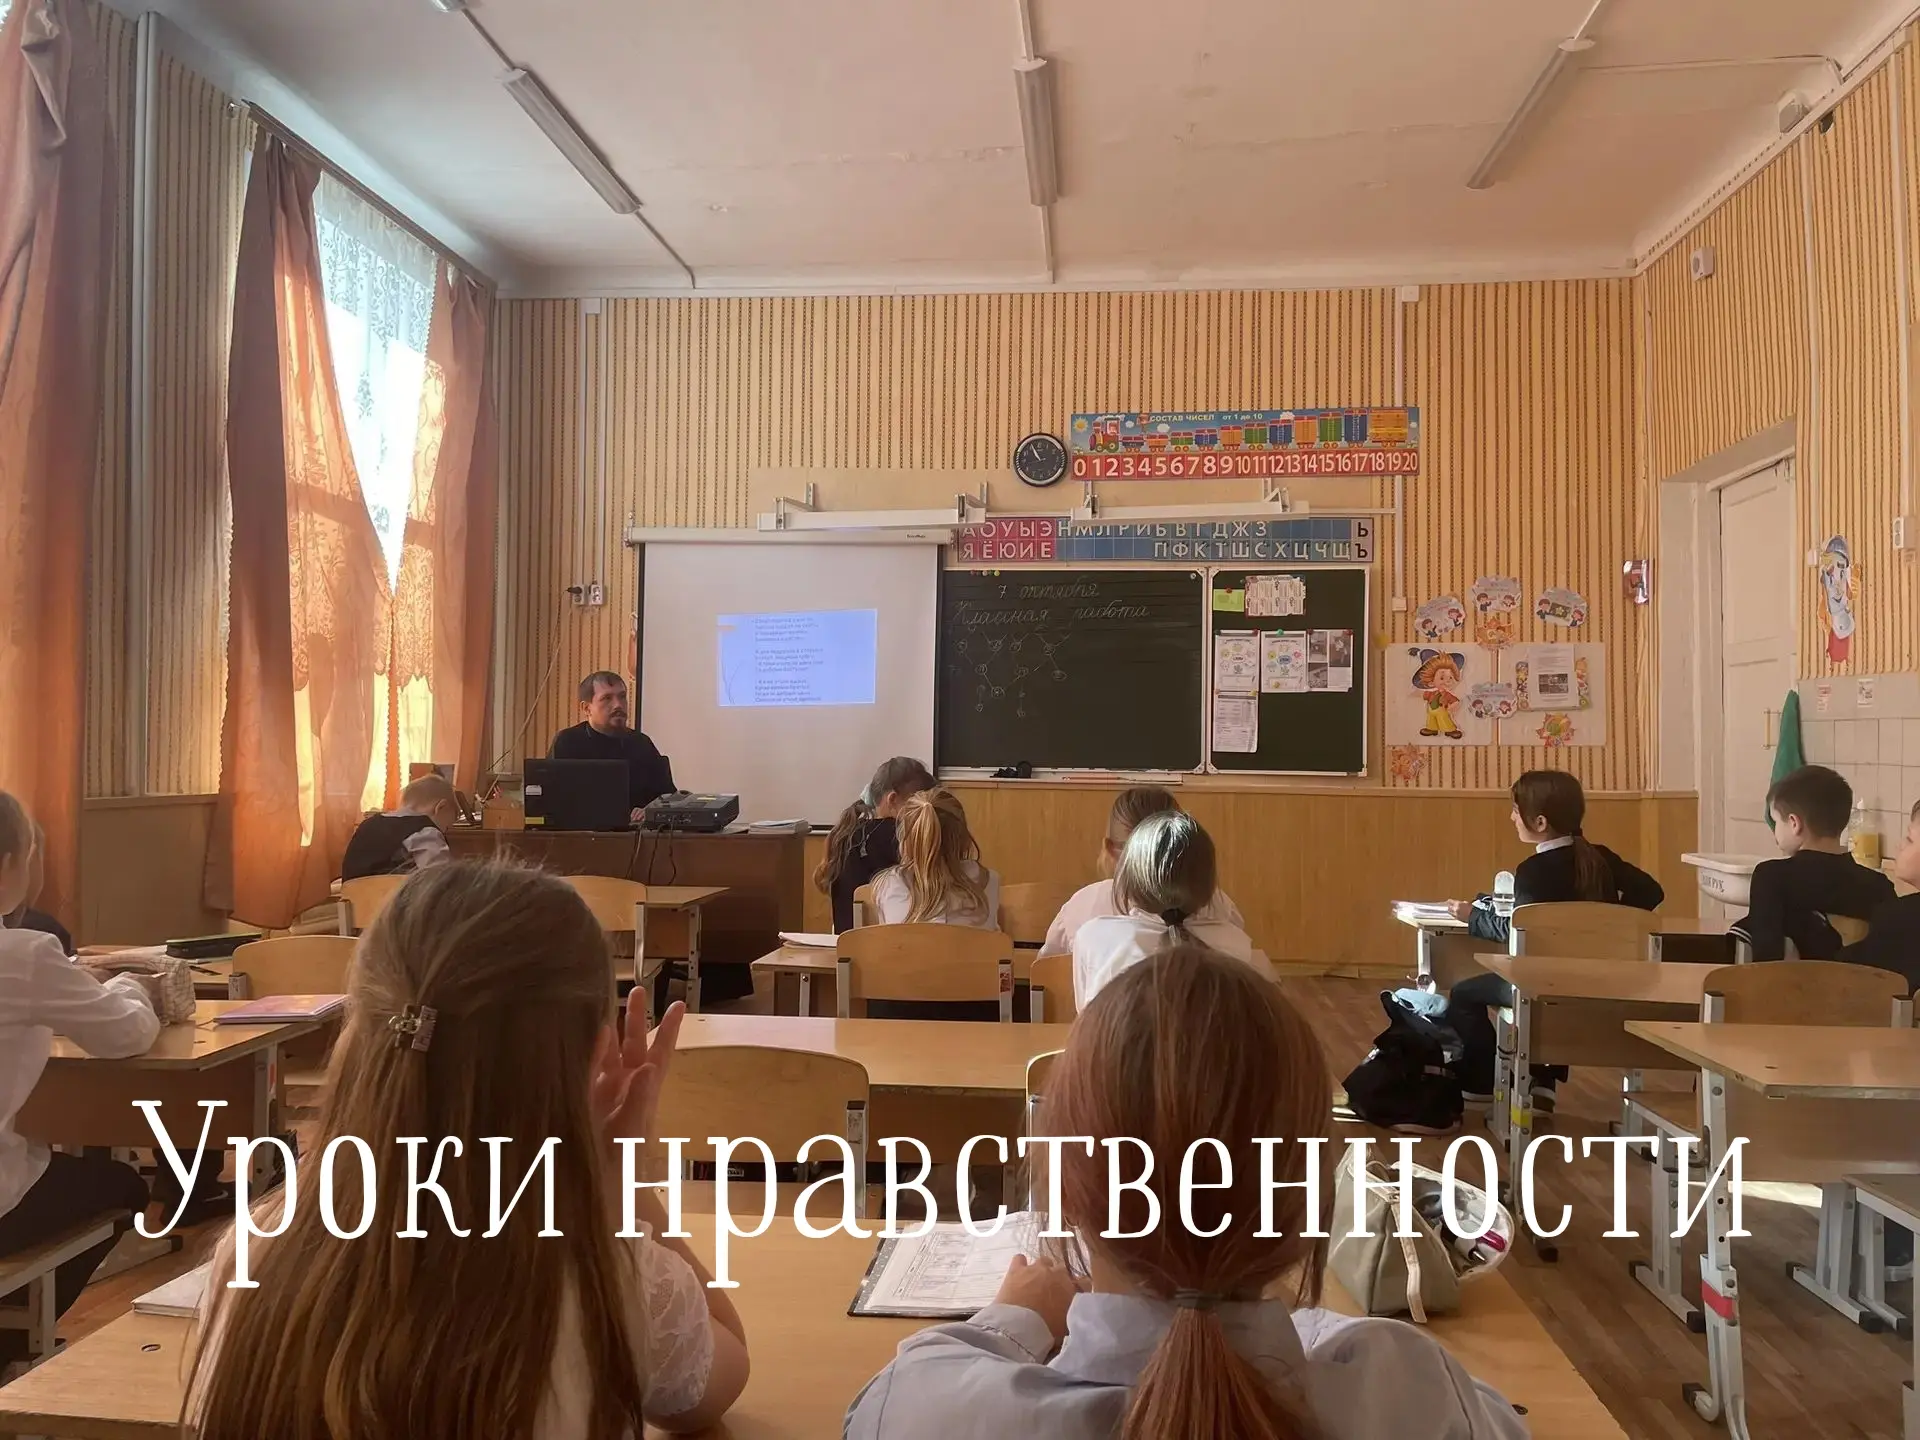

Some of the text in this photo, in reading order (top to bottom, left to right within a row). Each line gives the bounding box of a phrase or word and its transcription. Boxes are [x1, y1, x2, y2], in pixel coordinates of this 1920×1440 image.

[1150, 414, 1184, 422] СОСТАВ
[1074, 459, 1086, 476] 0
[1092, 459, 1100, 476] 1
[1106, 458, 1118, 476] 2
[1122, 458, 1134, 475] 3
[1138, 458, 1151, 475] 4
[1155, 457, 1166, 475] 5
[1170, 456, 1184, 475] 6
[1187, 456, 1200, 474] 7
[1203, 456, 1216, 474] 8
[1220, 456, 1233, 474] 9
[1236, 455, 1250, 474] 10
[1253, 456, 1266, 473] 11
[1269, 455, 1284, 473] 12
[1285, 454, 1300, 472] 13
[1302, 454, 1318, 472] 14
[1320, 454, 1334, 472] 15
[1336, 453, 1351, 472] 16
[1352, 452, 1368, 471] 17
[1369, 452, 1385, 471] 18
[1387, 452, 1401, 471] 19
[1402, 452, 1418, 470] 20
[980, 522, 997, 538] О
[1001, 521, 1013, 537] У
[1020, 521, 1034, 536] Ы
[1040, 521, 1053, 536] Э
[1058, 521, 1071, 536] Н
[1176, 523, 1187, 536] В
[1213, 522, 1228, 539] Д
[1233, 520, 1249, 536] Ж
[1256, 521, 1266, 537] З
[1358, 522, 1368, 537] Ь
[963, 541, 1368, 559] Я Ё Ю И Е П Ф К Т Ш С Х Ц Ч Щ Ъ
[998, 585, 1007, 599] 7
